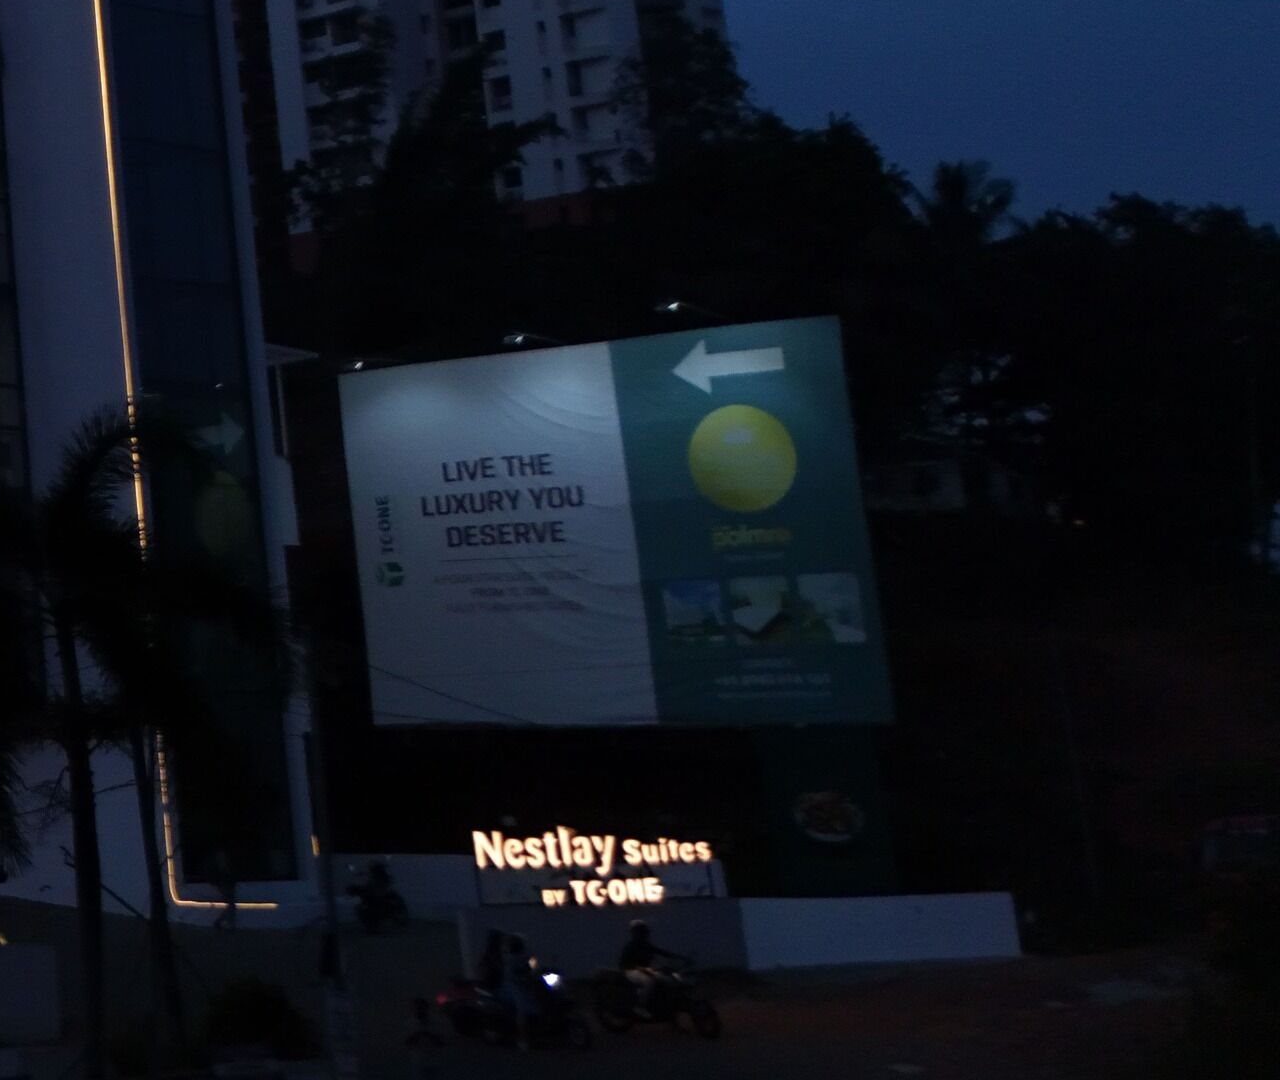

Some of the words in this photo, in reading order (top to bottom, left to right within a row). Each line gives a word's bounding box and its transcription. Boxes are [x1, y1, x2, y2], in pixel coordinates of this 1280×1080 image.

[442, 457, 496, 482] LIVE
[500, 453, 553, 477] THE
[421, 489, 521, 517] LUXURY
[527, 485, 585, 510] YOU
[446, 521, 567, 548] DESERVE
[472, 825, 616, 877] Nestlay
